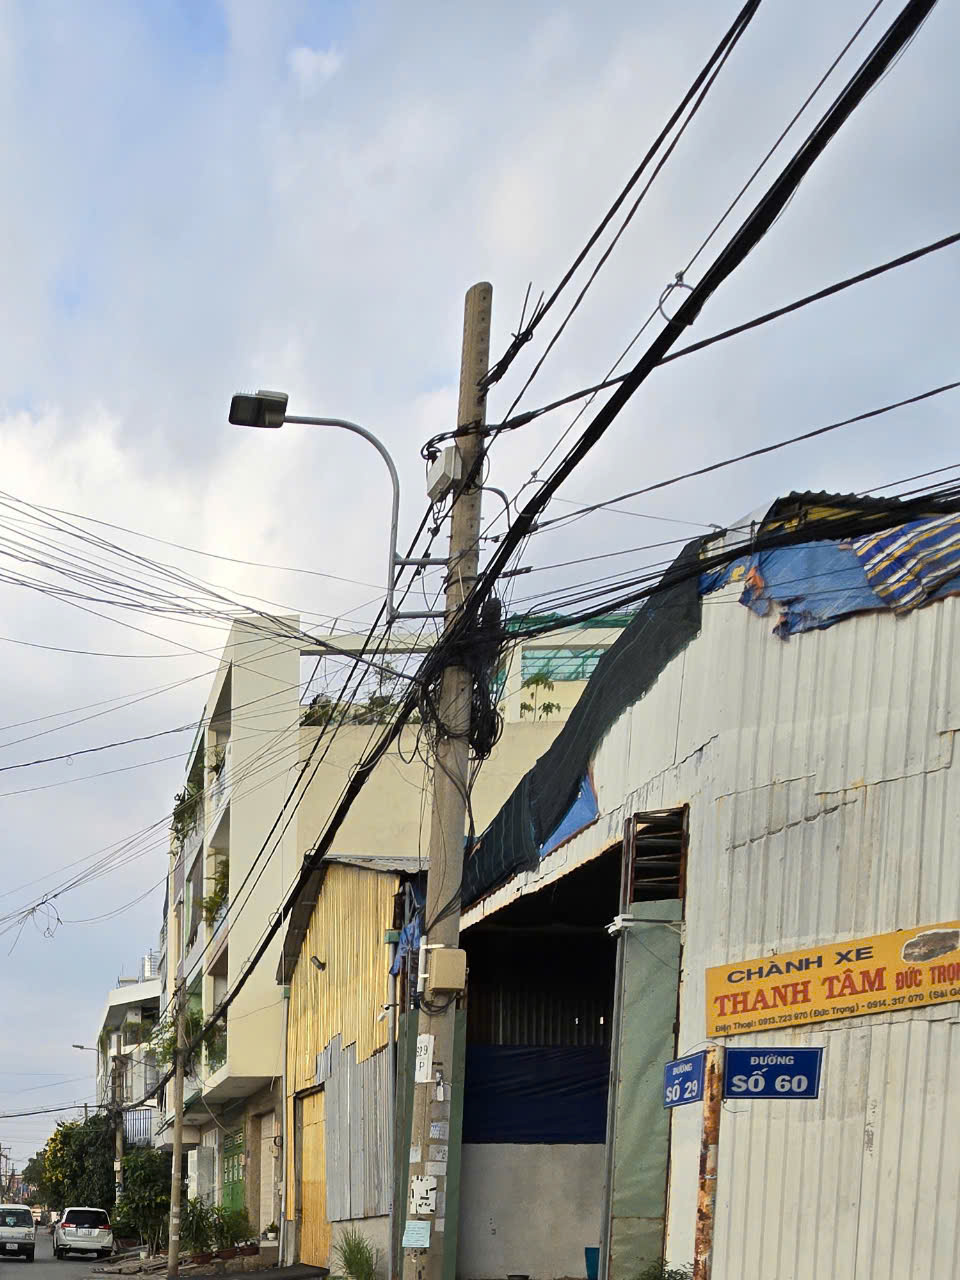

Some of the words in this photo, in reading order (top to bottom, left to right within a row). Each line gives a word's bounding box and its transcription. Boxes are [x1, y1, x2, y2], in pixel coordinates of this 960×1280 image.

[727, 956, 823, 983] CHÀNH
[834, 945, 874, 965] XE
[713, 980, 812, 1017] THANH
[821, 966, 887, 1000] TÂM
[895, 966, 923, 991] ĐỨC
[672, 1062, 693, 1076] ĐƯỜNG
[750, 1053, 795, 1066] ĐƯỜNG
[665, 1077, 683, 1103] SỐ
[683, 1079, 698, 1099] 29
[731, 1067, 769, 1093] SỐ
[774, 1075, 809, 1093] 60
